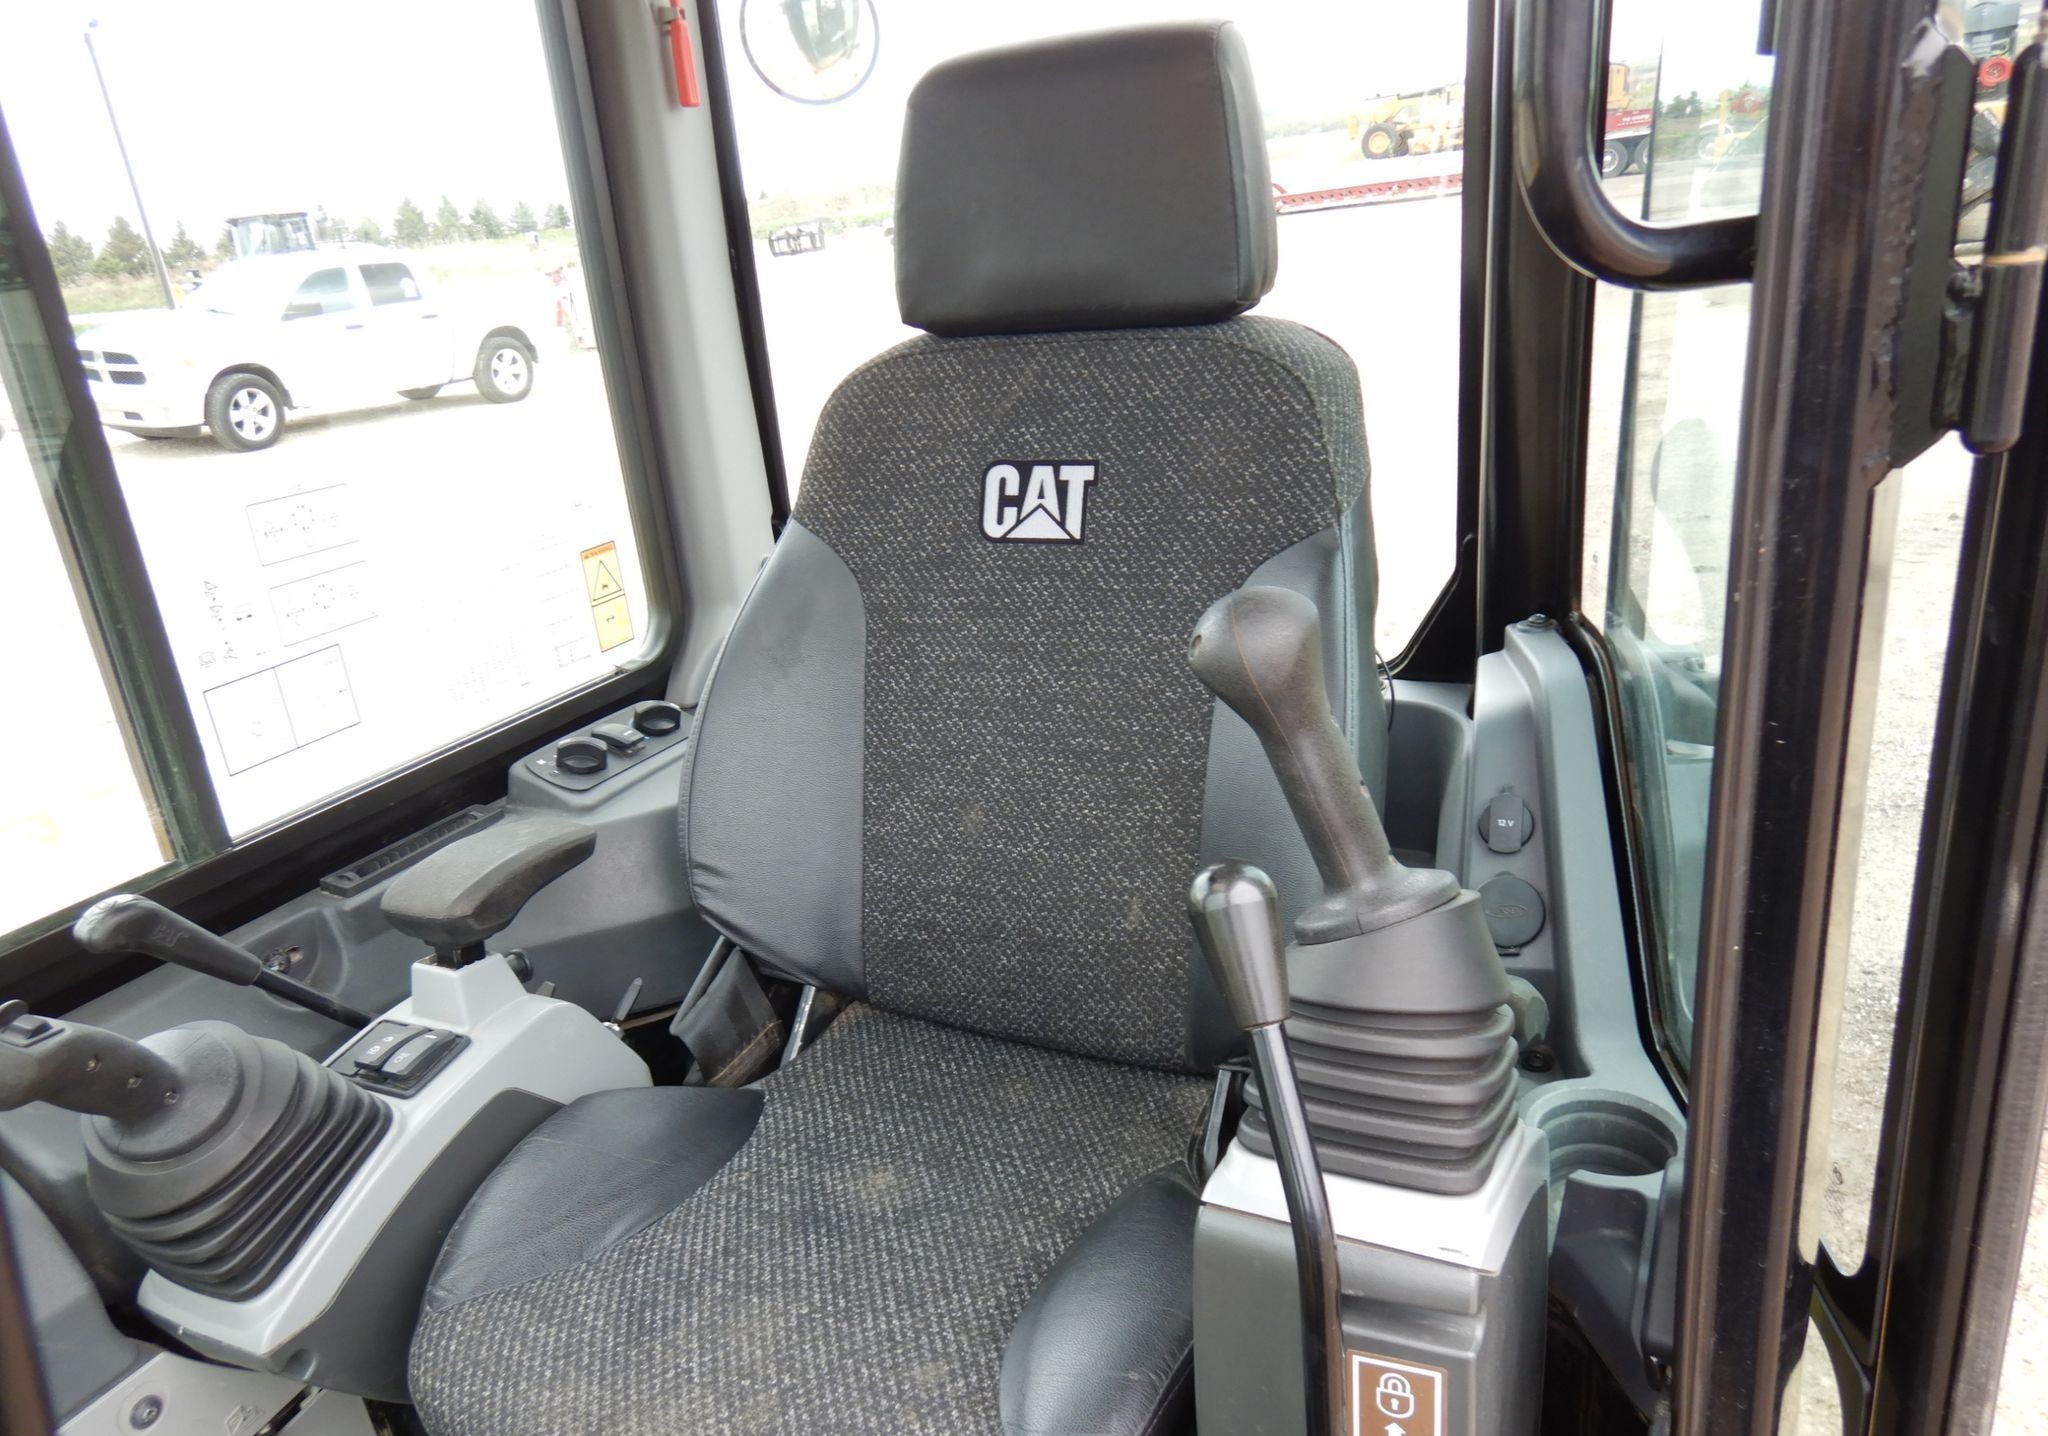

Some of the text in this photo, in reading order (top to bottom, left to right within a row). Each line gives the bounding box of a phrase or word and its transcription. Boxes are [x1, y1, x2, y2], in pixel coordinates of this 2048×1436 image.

[983, 464, 1095, 540] CAT
[1496, 819, 1515, 827] 12 V
